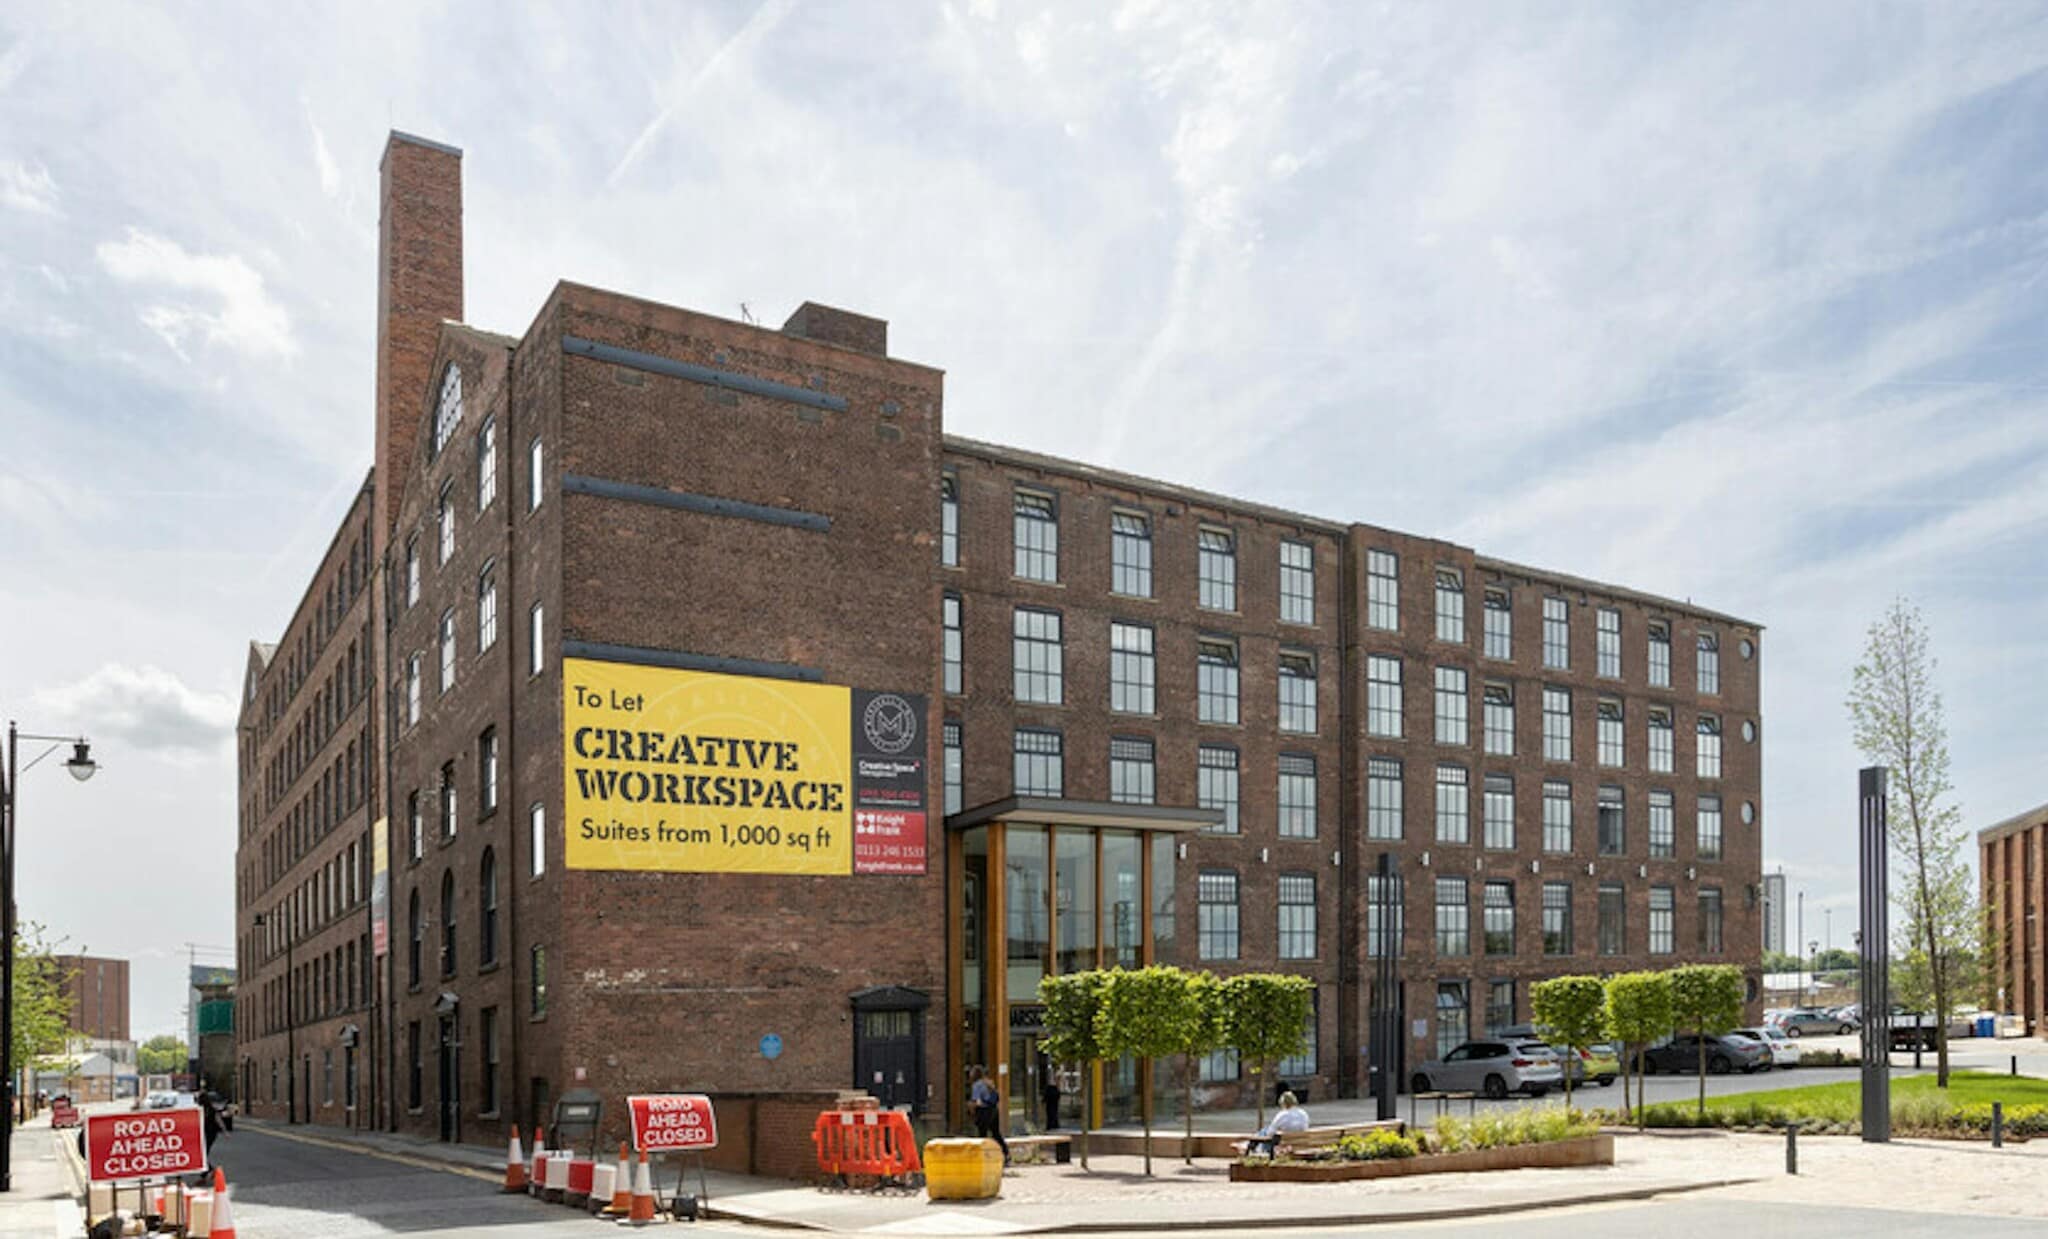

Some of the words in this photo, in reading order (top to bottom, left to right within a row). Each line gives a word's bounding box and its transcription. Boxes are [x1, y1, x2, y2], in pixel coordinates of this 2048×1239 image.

[573, 685, 602, 708] To
[611, 689, 644, 712] Let
[574, 727, 799, 771] CREATIVE
[574, 768, 843, 812] WORKSPACE
[581, 818, 650, 841] Suites
[657, 820, 711, 843] from
[720, 824, 780, 848] 1,000
[787, 835, 809, 852] sq
[816, 827, 831, 848] ft
[648, 1099, 692, 1112] ROAD
[114, 1118, 176, 1137] ROAD
[648, 1112, 701, 1128] AHEAD
[111, 1135, 183, 1156] AHEAD
[643, 1127, 707, 1144] CLOSED
[104, 1152, 190, 1174] CLOSED
